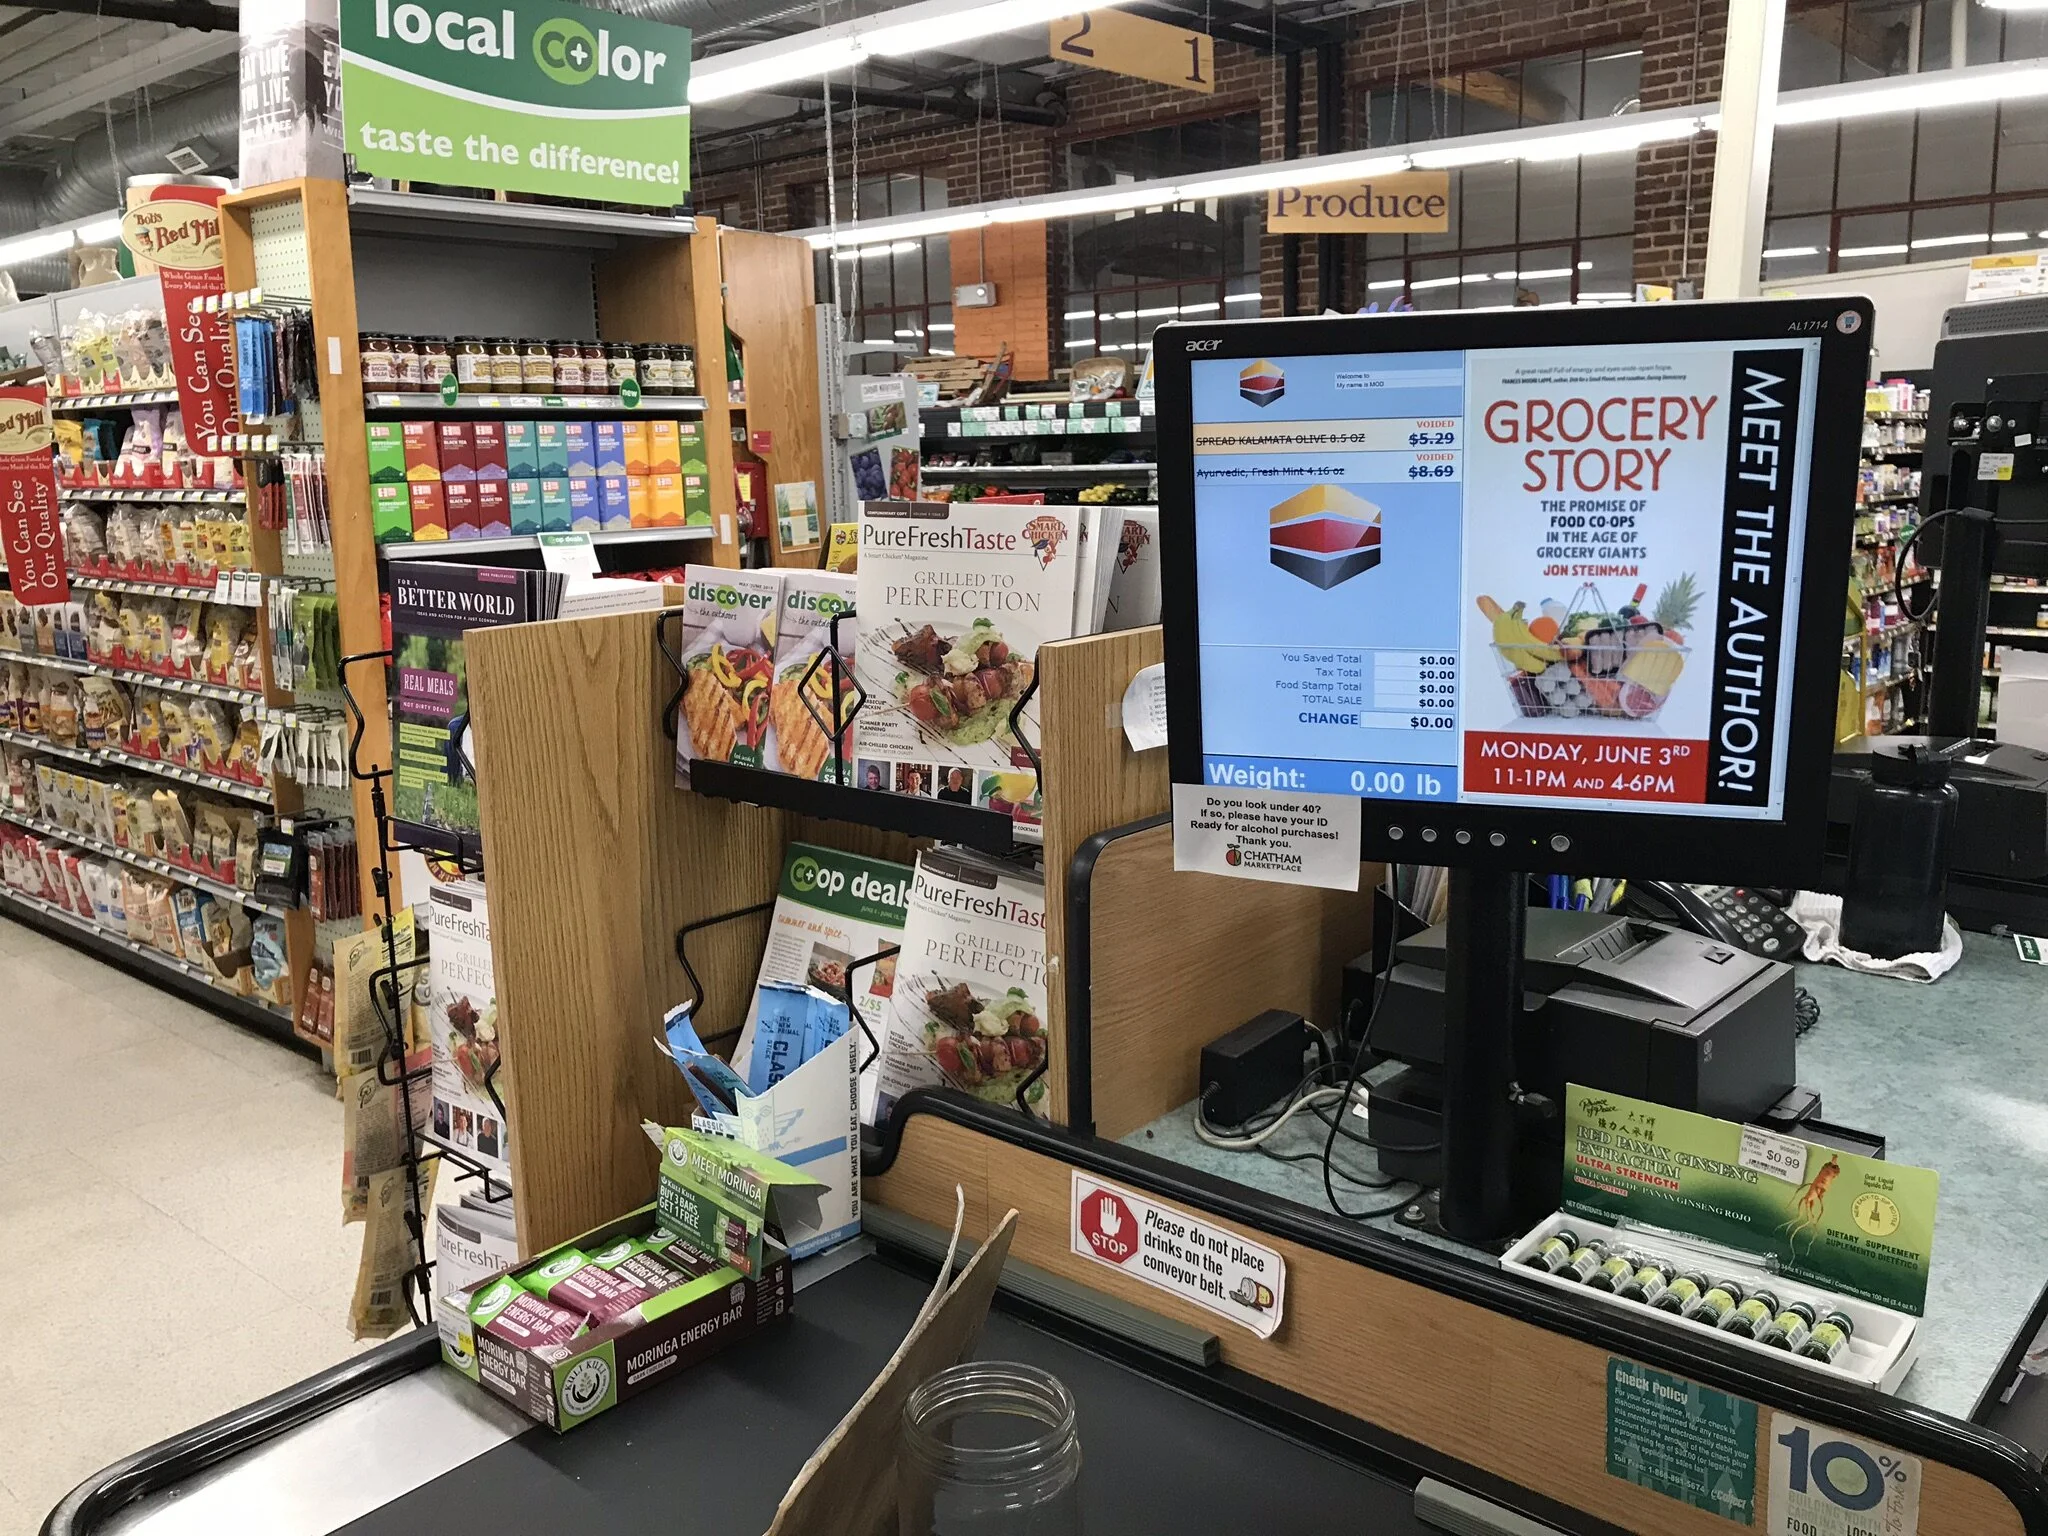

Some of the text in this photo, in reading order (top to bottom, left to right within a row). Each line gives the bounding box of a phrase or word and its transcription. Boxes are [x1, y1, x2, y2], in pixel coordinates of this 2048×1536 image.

[374, 0, 516, 59] local
[1061, 10, 1094, 58] 2
[1184, 37, 1206, 84] 1
[360, 121, 680, 186] taste the difference!
[1272, 185, 1446, 219] Produce
[134, 213, 162, 225] Bob's
[155, 217, 220, 252] Red Mil
[1788, 320, 1828, 331] AL1714
[1186, 338, 1222, 351] acer
[188, 350, 217, 440] You Can
[442, 385, 456, 395] new
[622, 387, 638, 398] new
[16, 409, 44, 434] Mill
[1416, 420, 1454, 429] VOIDED
[1484, 395, 1719, 443] GROCERY
[1196, 436, 1236, 446] SPREAD
[1239, 435, 1292, 445] KALAMATA
[1295, 434, 1327, 444] OLIVE
[1350, 433, 1365, 443] OZ
[1408, 432, 1455, 446] $5.29
[1416, 453, 1454, 462] VOIDED
[1522, 448, 1671, 492] STORY
[1197, 467, 1248, 478] Ayurvedic,
[1252, 467, 1279, 476] Fresh
[1282, 466, 1304, 476] Mint
[1408, 465, 1454, 479] $8.69
[1541, 500, 1646, 512] THE PROMISE OF
[1028, 520, 1063, 533] SMART
[1550, 515, 1635, 528] FOOD CO-OPS
[8, 480, 37, 592] You Can See
[863, 524, 1017, 551] PureFreshTaste
[1021, 528, 1068, 541] CHICKEN
[1546, 531, 1638, 543] IN THE AGE OF
[1537, 546, 1647, 559] GROCERY GIANTS
[42, 553, 58, 589] Our
[914, 570, 1014, 588] GRILLED TO
[1543, 565, 1638, 577] JON STEINMAN
[1718, 368, 1786, 793] MEET THE AUTHOR!
[688, 582, 771, 609] discover
[886, 586, 1041, 612] PERFECTION
[1282, 654, 1455, 666] You Saved Total $0.00
[404, 673, 454, 696] REAL MEALS
[1316, 668, 1455, 680] Tax Total $0.00
[1276, 681, 1455, 694] Food Stamp Total $0.00
[1302, 695, 1455, 708] TOTAL SALE $0.00
[1299, 713, 1454, 730] CHANGE $0.00
[1480, 739, 1691, 766] MONDAY, JUNE 3RD
[1209, 763, 1441, 795] Weight: 0.00 lb
[1493, 768, 1675, 794] 11-1PM AND 4-6PM
[1200, 809, 1328, 827] If so, please have your ID
[1206, 797, 1321, 814] Do you look under 40?
[1190, 821, 1338, 840] Ready for alcohol purchases!
[1236, 835, 1292, 849] Thank you.
[1244, 851, 1302, 864] CHATHAM
[1244, 861, 1302, 872] MARKETPLACE
[850, 1042, 858, 1079] WISELY.
[850, 1081, 858, 1112] CHOOSE
[1576, 1140, 1681, 1179] EXTRACTUM
[1577, 1126, 1612, 1145] RED
[1617, 1135, 1671, 1161] PANAX
[1674, 1152, 1759, 1184] GINSENG
[1767, 1150, 1799, 1168] $0.99
[691, 1152, 716, 1175] MEET
[717, 1167, 762, 1200] MORINGA
[1576, 1155, 1679, 1191] ULTRA STRENGTH
[659, 1198, 699, 1229] GET 1 FREE
[660, 1186, 699, 1217] BUY 3 BARS,
[1091, 1232, 1128, 1256] STOP
[1144, 1231, 1223, 1276] drinks on the
[1145, 1209, 1265, 1273] Please do not place
[1827, 1229, 1920, 1260] DIETARY SUPPLEMENT
[1143, 1254, 1226, 1300] conveyor belt.
[627, 1306, 743, 1374] MORINGA ENERGY BAR
[1615, 1369, 1688, 1405] Check Policy
[1778, 1426, 1907, 1511] 10%
